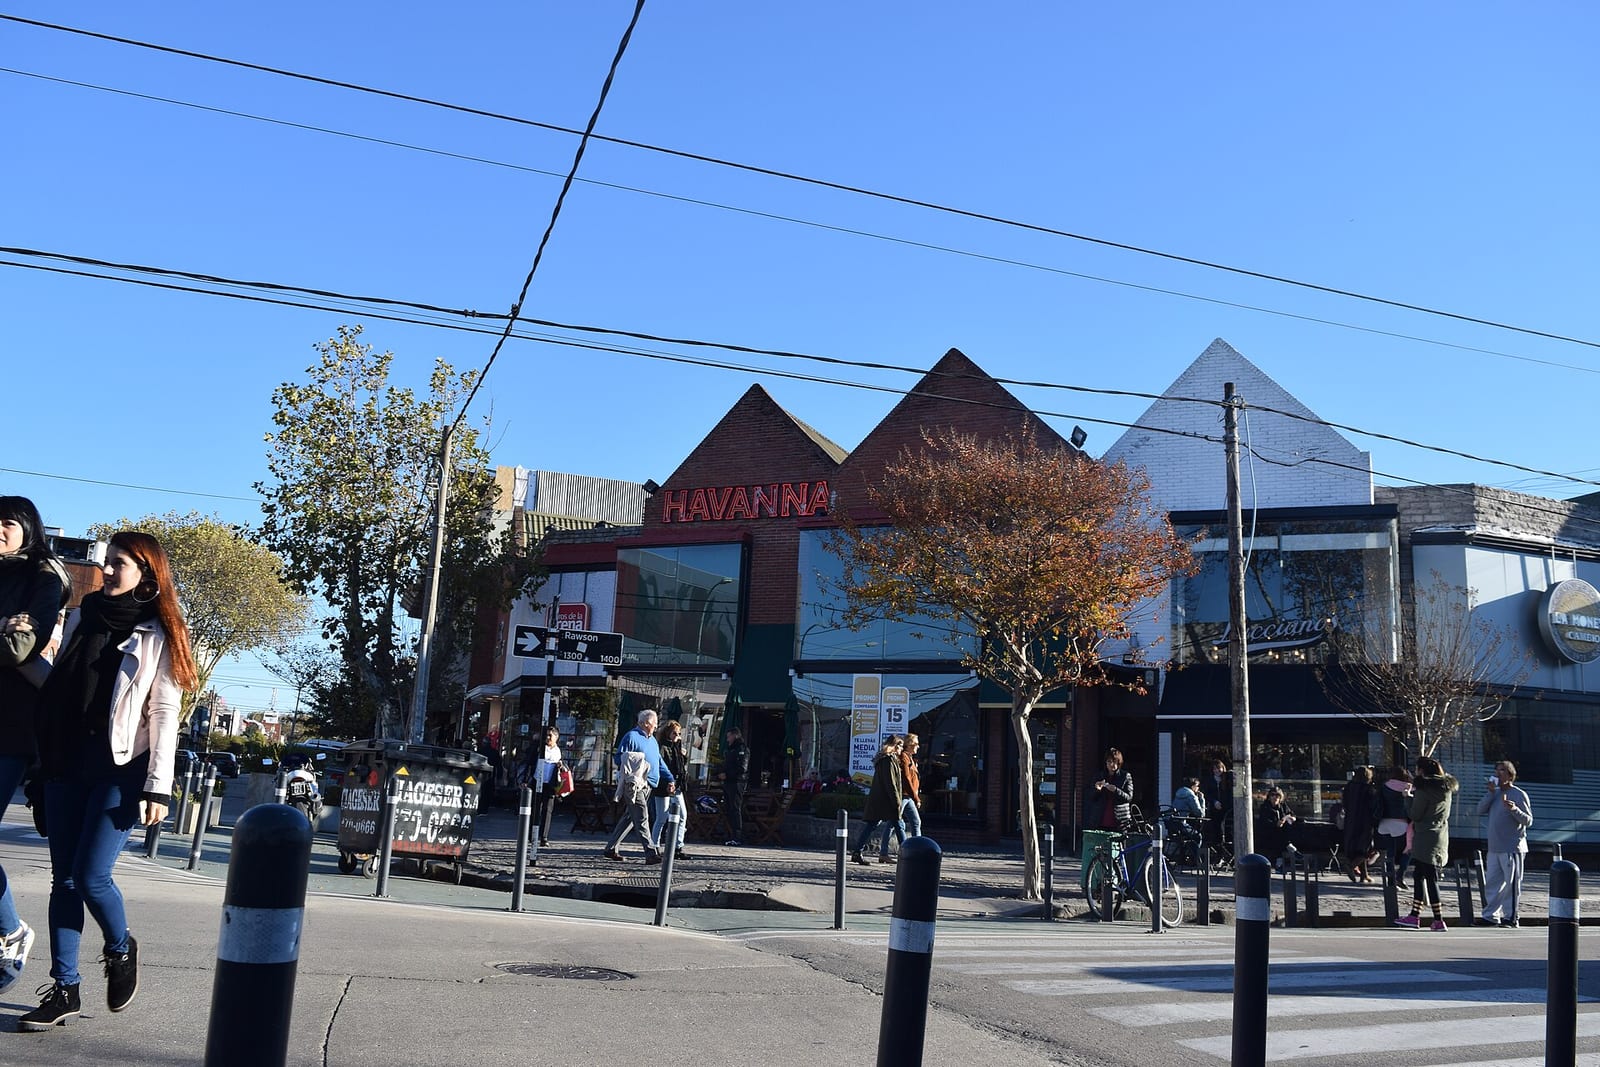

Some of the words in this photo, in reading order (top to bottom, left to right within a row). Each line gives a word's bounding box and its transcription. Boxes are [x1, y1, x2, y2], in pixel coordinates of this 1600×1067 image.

[662, 480, 829, 523] HAVANNA
[568, 612, 576, 620] de
[557, 620, 583, 631] rena
[1572, 614, 1600, 629] MONE
[564, 632, 598, 642] Rawson
[563, 652, 583, 660] 1300
[600, 655, 620, 664] 1400
[856, 711, 862, 720] 2
[855, 722, 861, 731] 2
